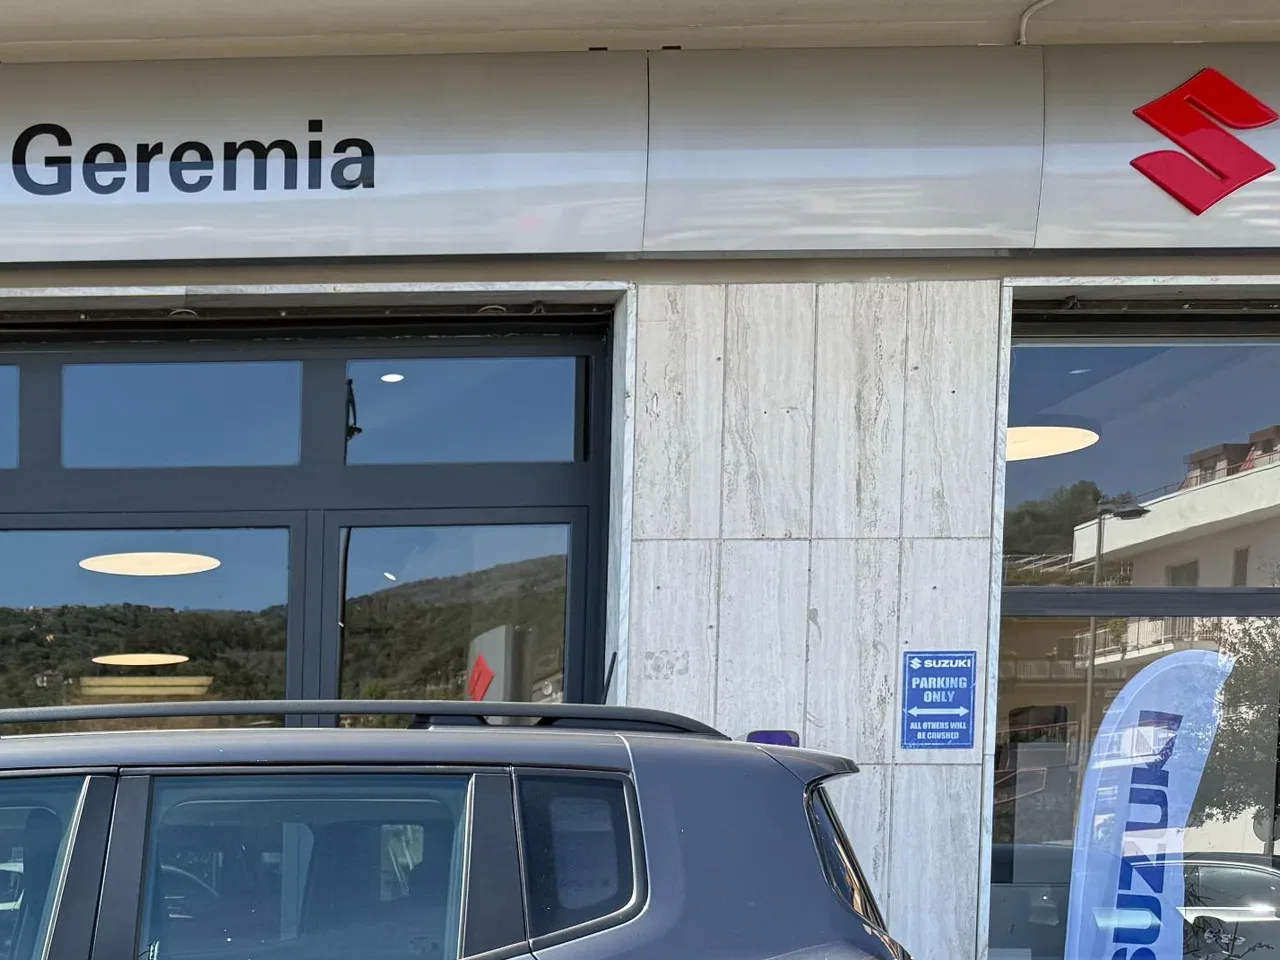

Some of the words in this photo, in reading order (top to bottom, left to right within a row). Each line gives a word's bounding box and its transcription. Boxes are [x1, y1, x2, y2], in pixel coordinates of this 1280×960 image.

[11, 119, 375, 196] Geremia
[923, 659, 971, 668] SUZUKI
[911, 677, 968, 689] PARKING
[923, 691, 955, 702] ONLY
